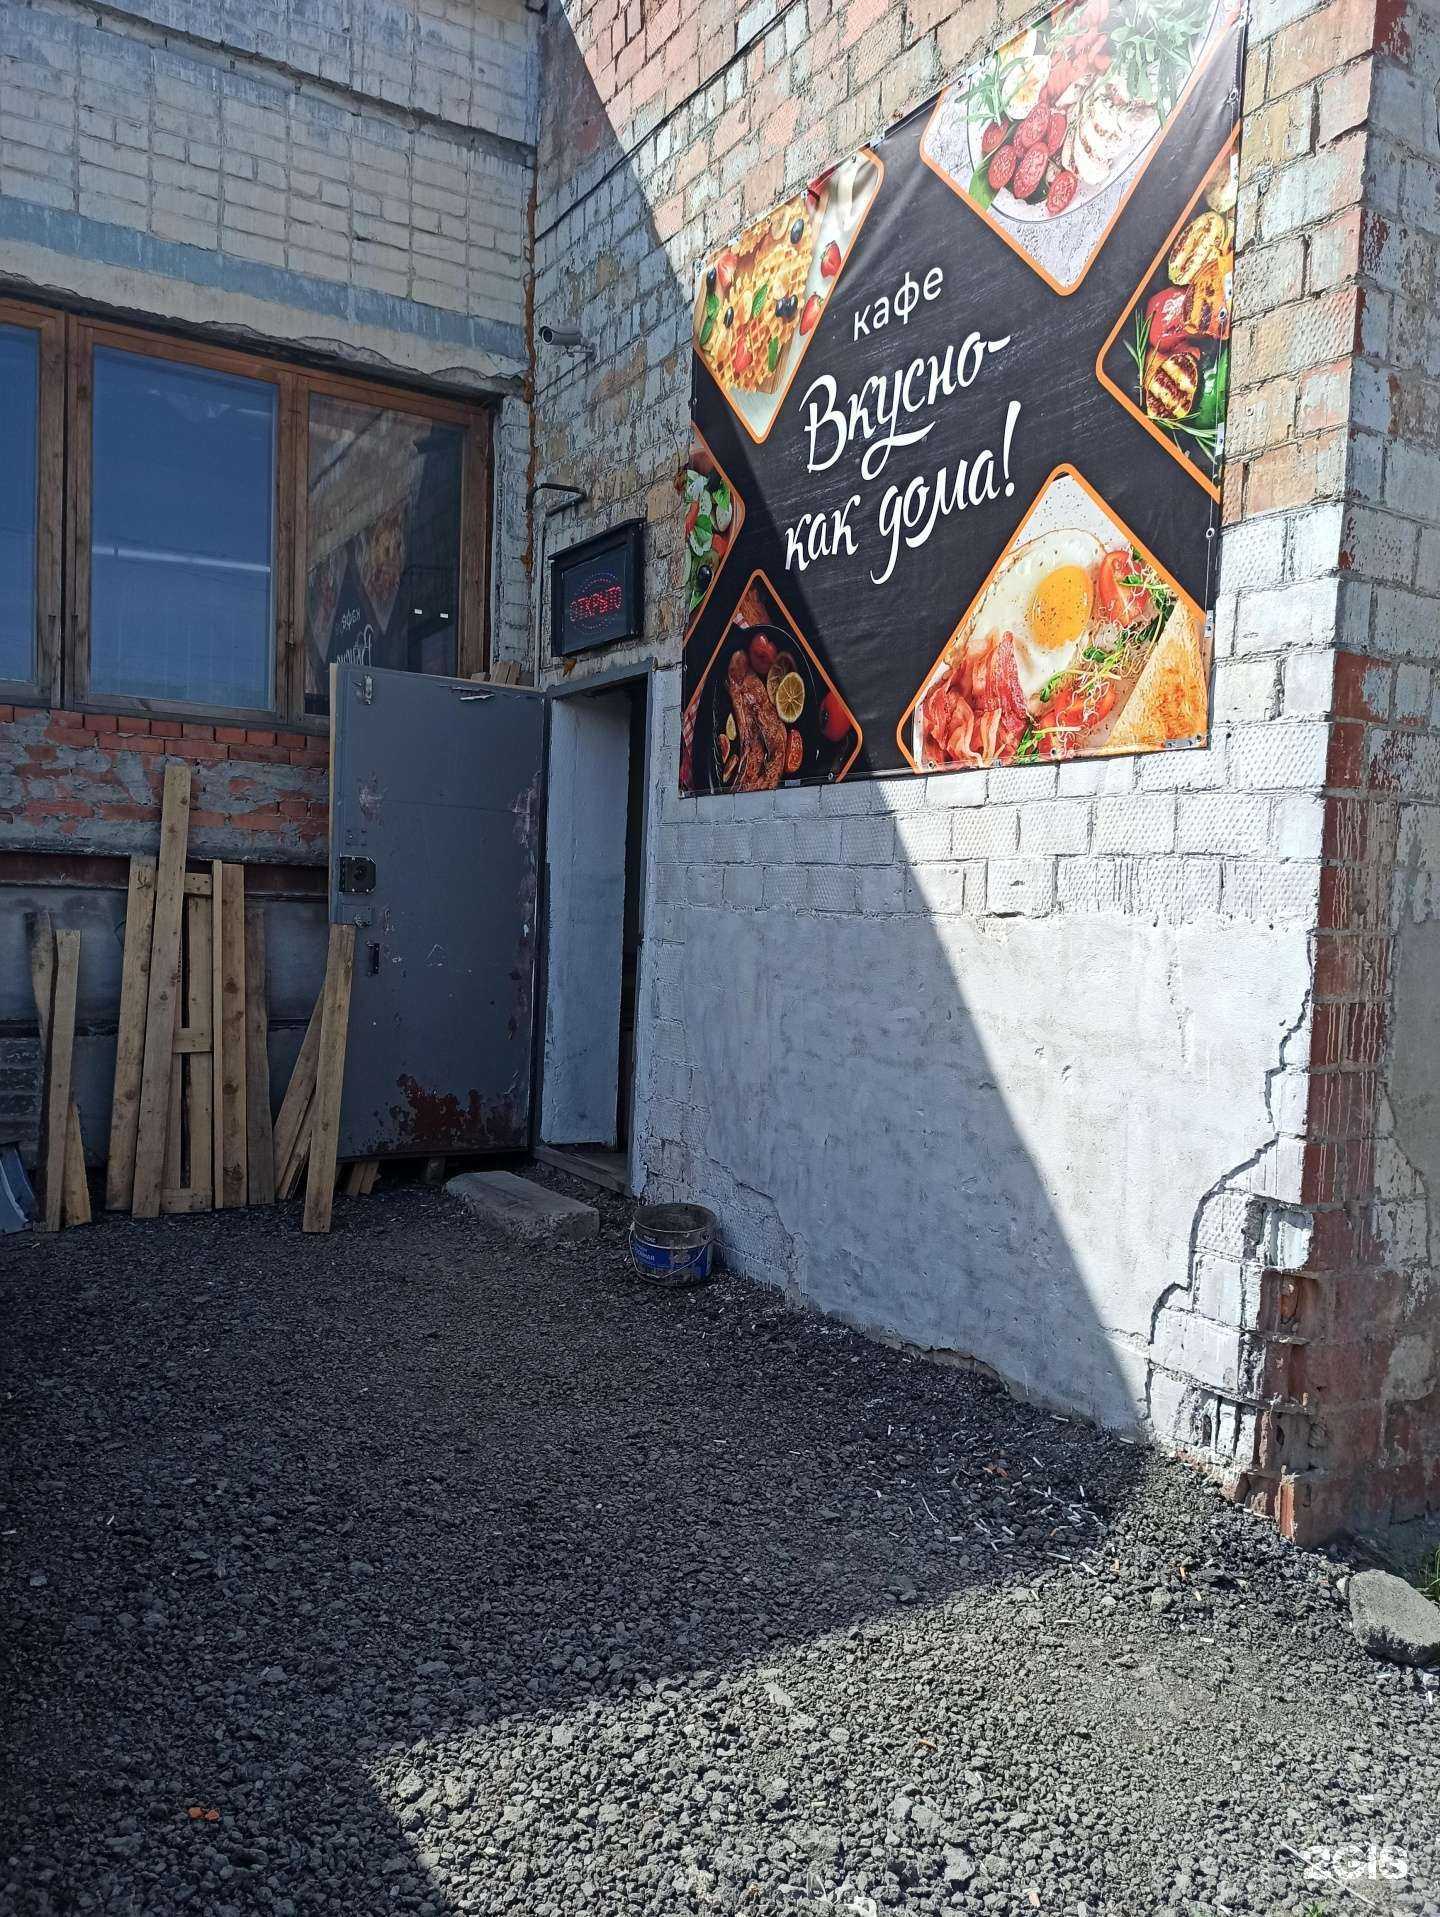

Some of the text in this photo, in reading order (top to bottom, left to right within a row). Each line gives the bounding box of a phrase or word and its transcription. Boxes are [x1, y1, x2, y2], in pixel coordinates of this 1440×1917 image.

[852, 266, 945, 342] кафе
[784, 400, 1022, 586] как дома!
[569, 586, 622, 622] ОТКРЫТО
